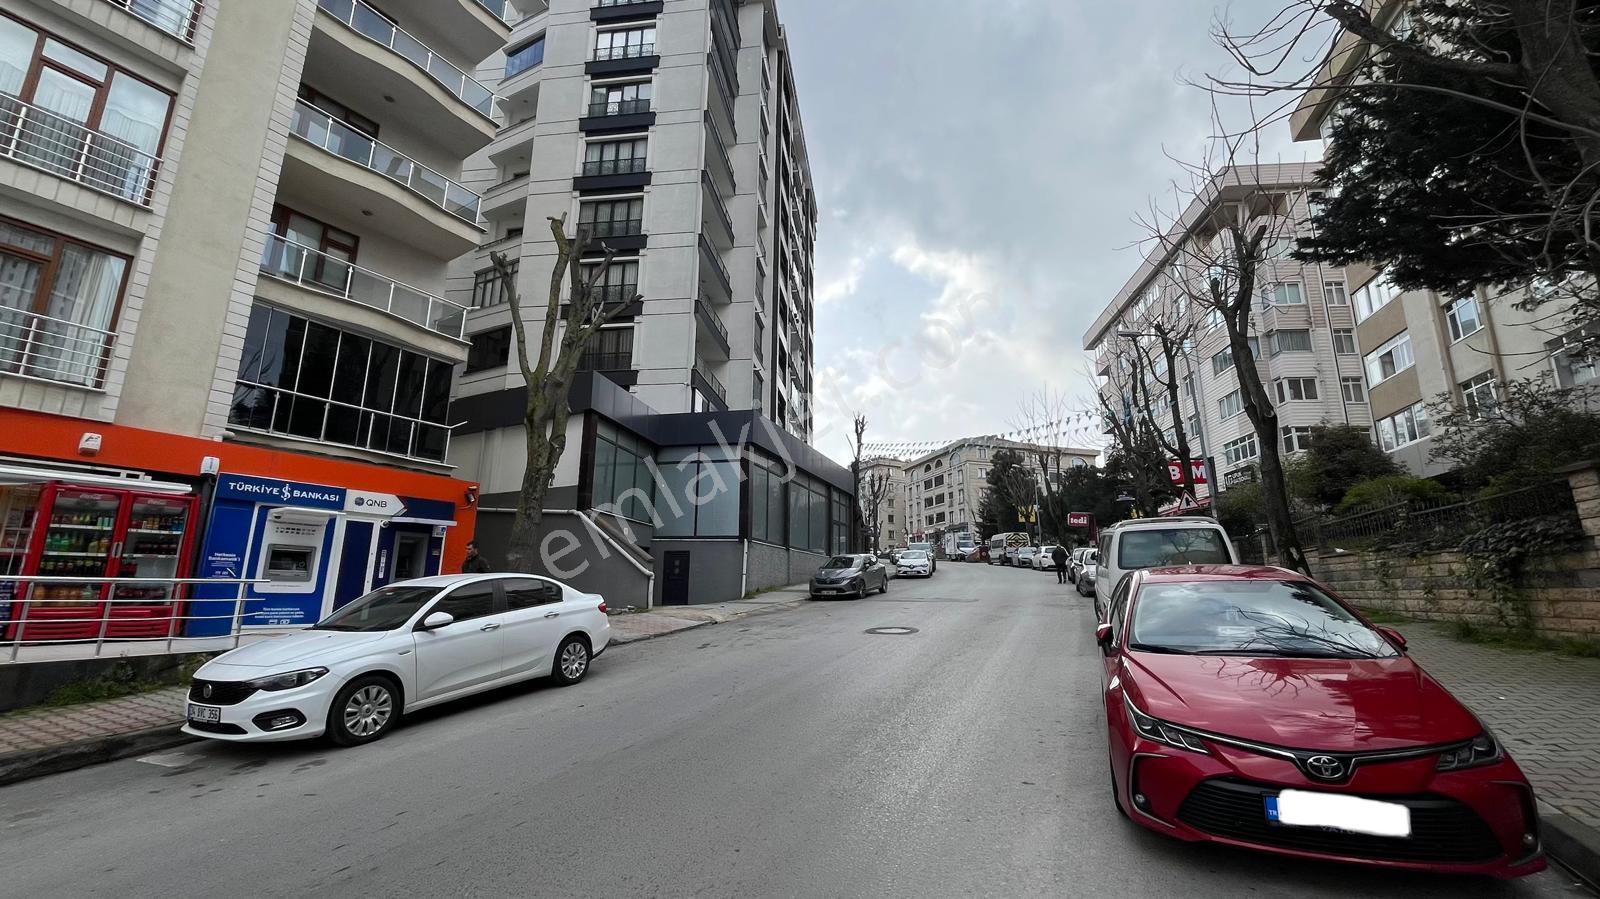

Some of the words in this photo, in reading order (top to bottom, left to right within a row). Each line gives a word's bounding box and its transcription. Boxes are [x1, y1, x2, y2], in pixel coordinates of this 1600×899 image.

[1168, 465, 1207, 480] BM
[229, 482, 279, 495] TÜRKİYE
[293, 490, 339, 501] BANKASI
[366, 499, 387, 507] QNB
